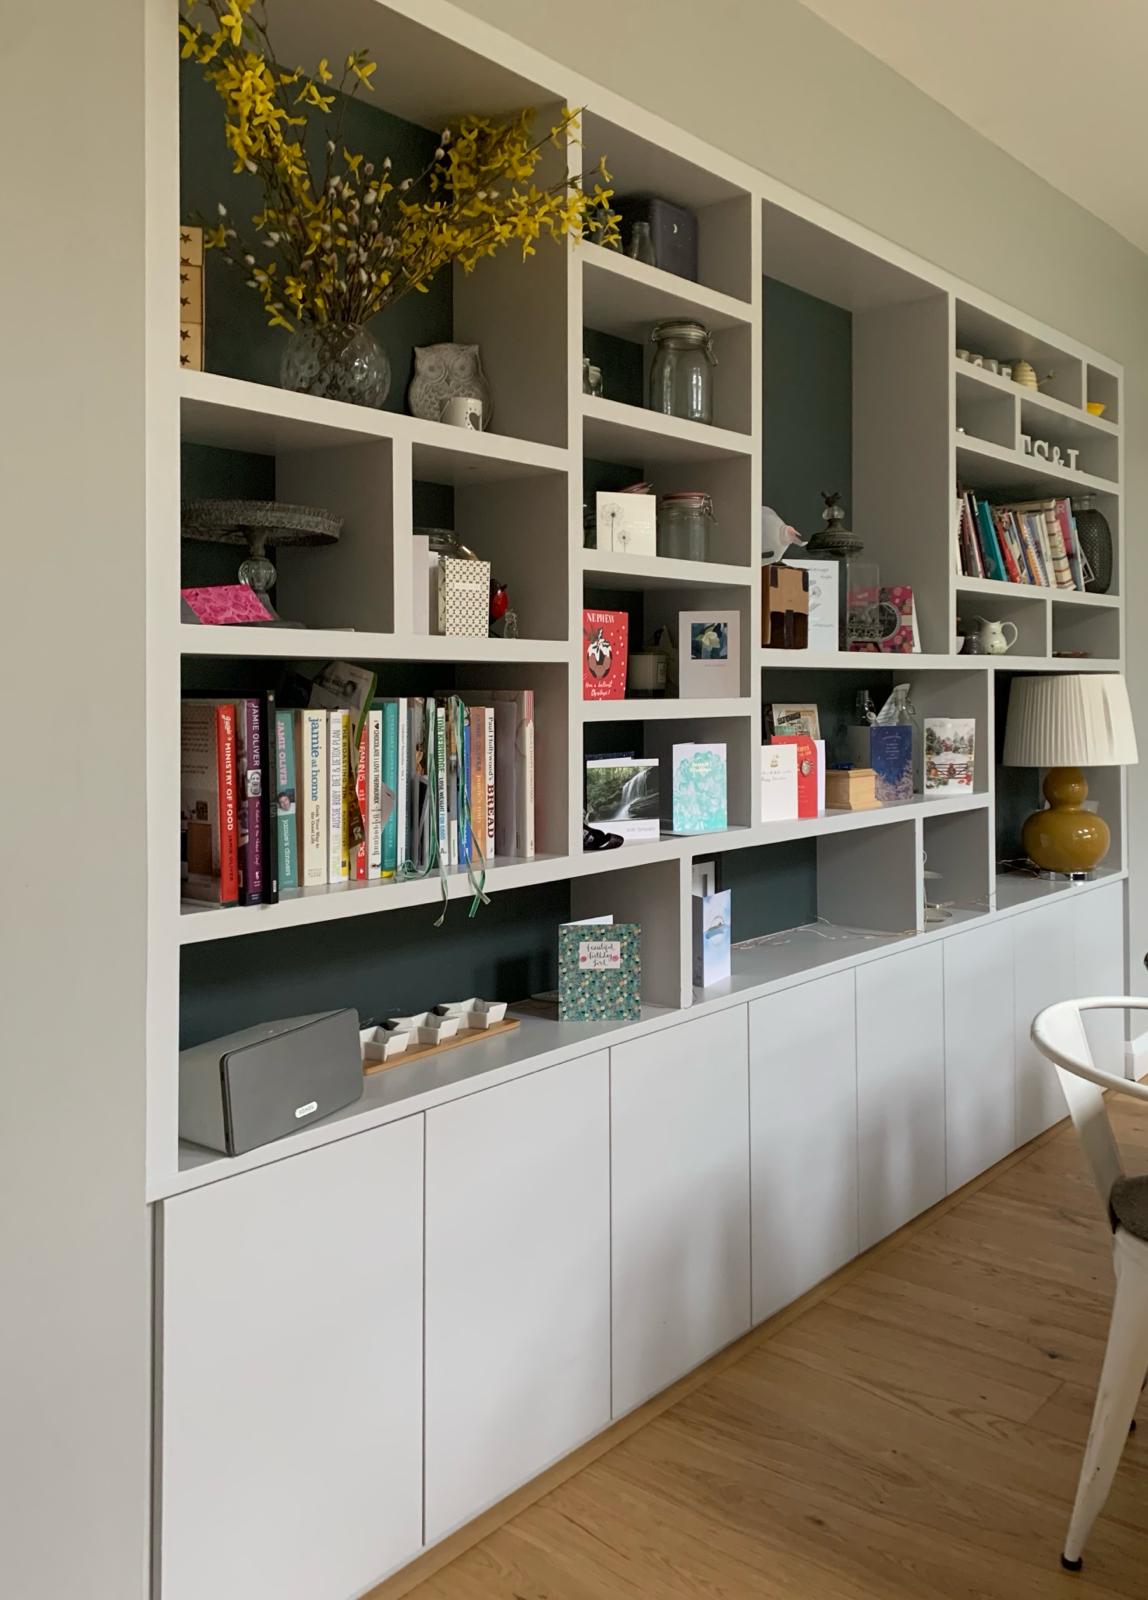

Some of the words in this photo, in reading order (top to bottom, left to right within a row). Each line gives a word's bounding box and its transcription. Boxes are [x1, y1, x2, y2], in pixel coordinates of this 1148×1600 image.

[586, 613, 615, 623] NEPHEW
[251, 703, 260, 730] JAMIE
[277, 720, 288, 750] JAMIE
[308, 717, 322, 758] jamie
[332, 729, 340, 746] PLAN
[341, 724, 349, 741] THE
[224, 742, 233, 785] MINISTRY
[252, 733, 260, 766] OLIVER
[311, 759, 318, 768] at
[341, 742, 349, 784] ROASTING
[437, 734, 446, 774] KERRIDGE
[486, 735, 494, 781] Hollywood's
[279, 752, 289, 785] OLIVER
[226, 788, 233, 801] OF
[311, 770, 321, 801] home
[438, 791, 446, 812] WEIGHT
[226, 804, 234, 831] FOOD
